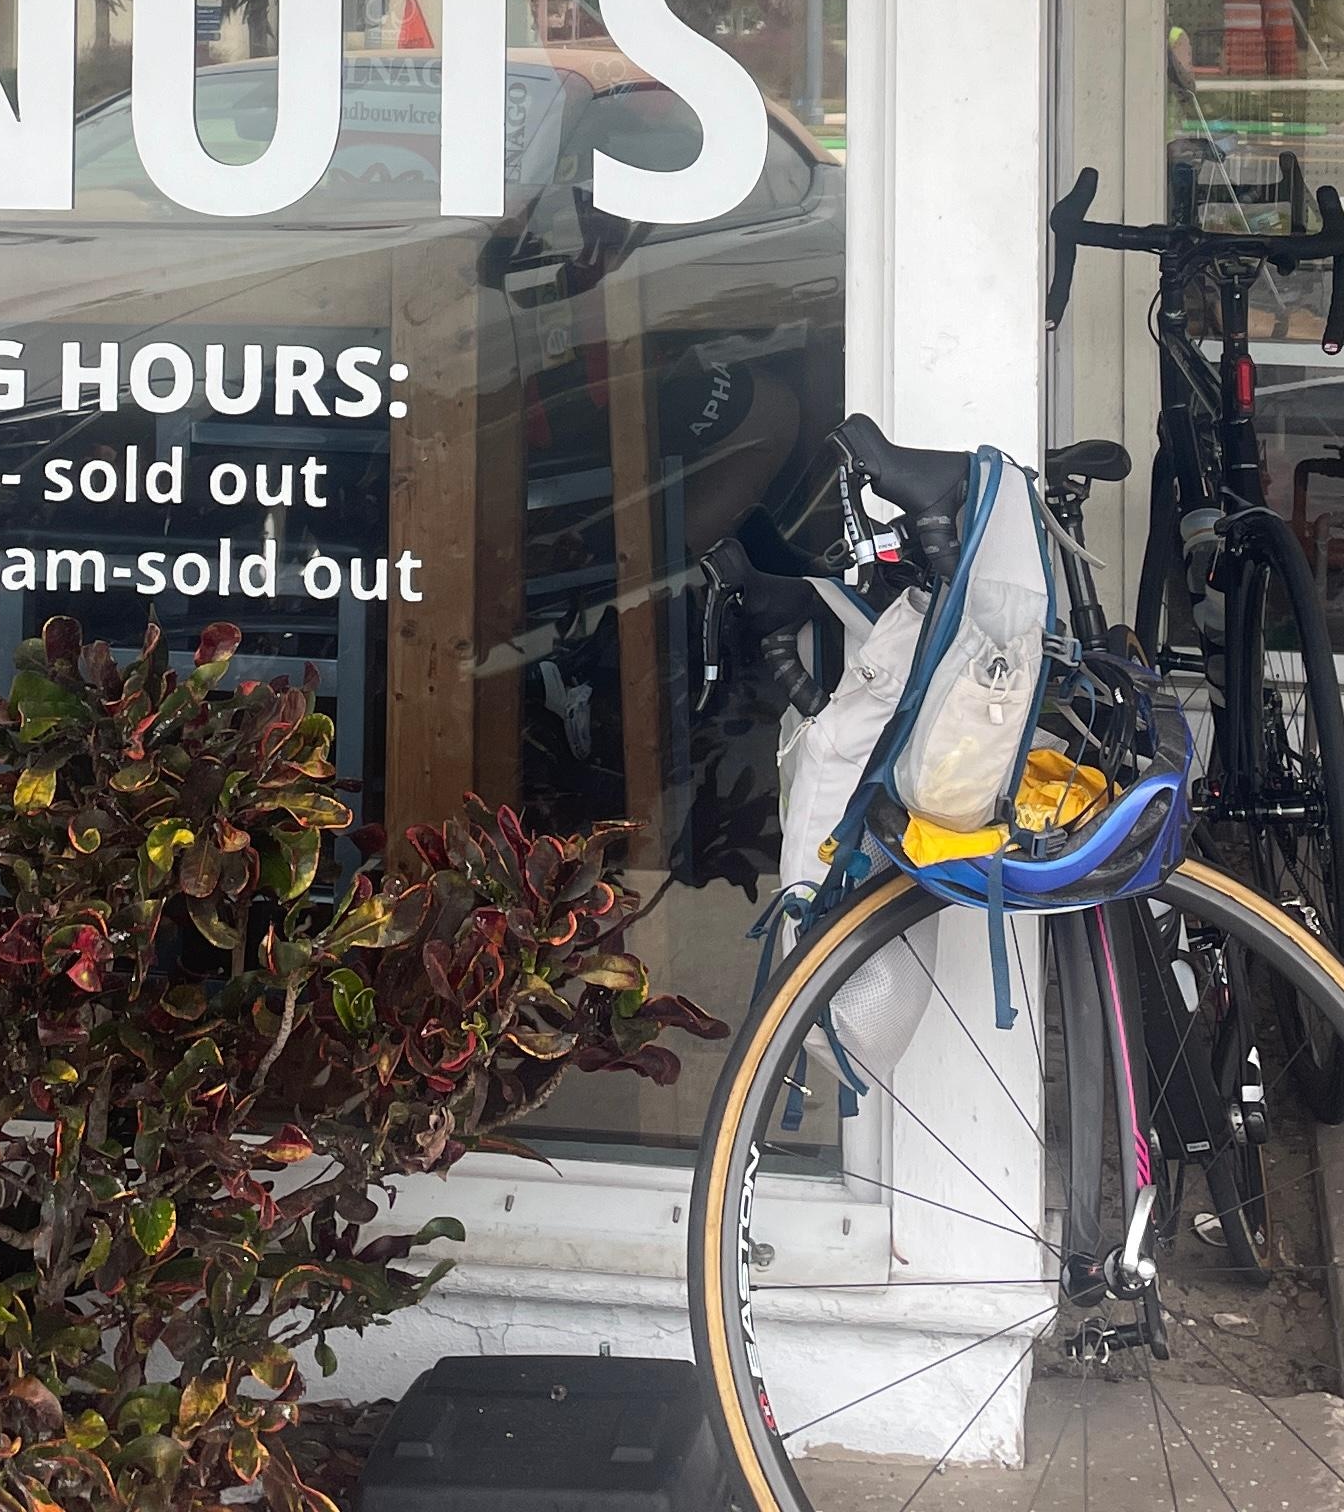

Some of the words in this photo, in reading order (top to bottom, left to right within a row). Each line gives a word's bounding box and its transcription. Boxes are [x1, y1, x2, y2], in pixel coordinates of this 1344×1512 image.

[61, 340, 411, 419] HOURS:
[43, 445, 185, 507] sold
[208, 456, 329, 510] out
[300, 544, 424, 604] out
[737, 1140, 762, 1380] EASTON
